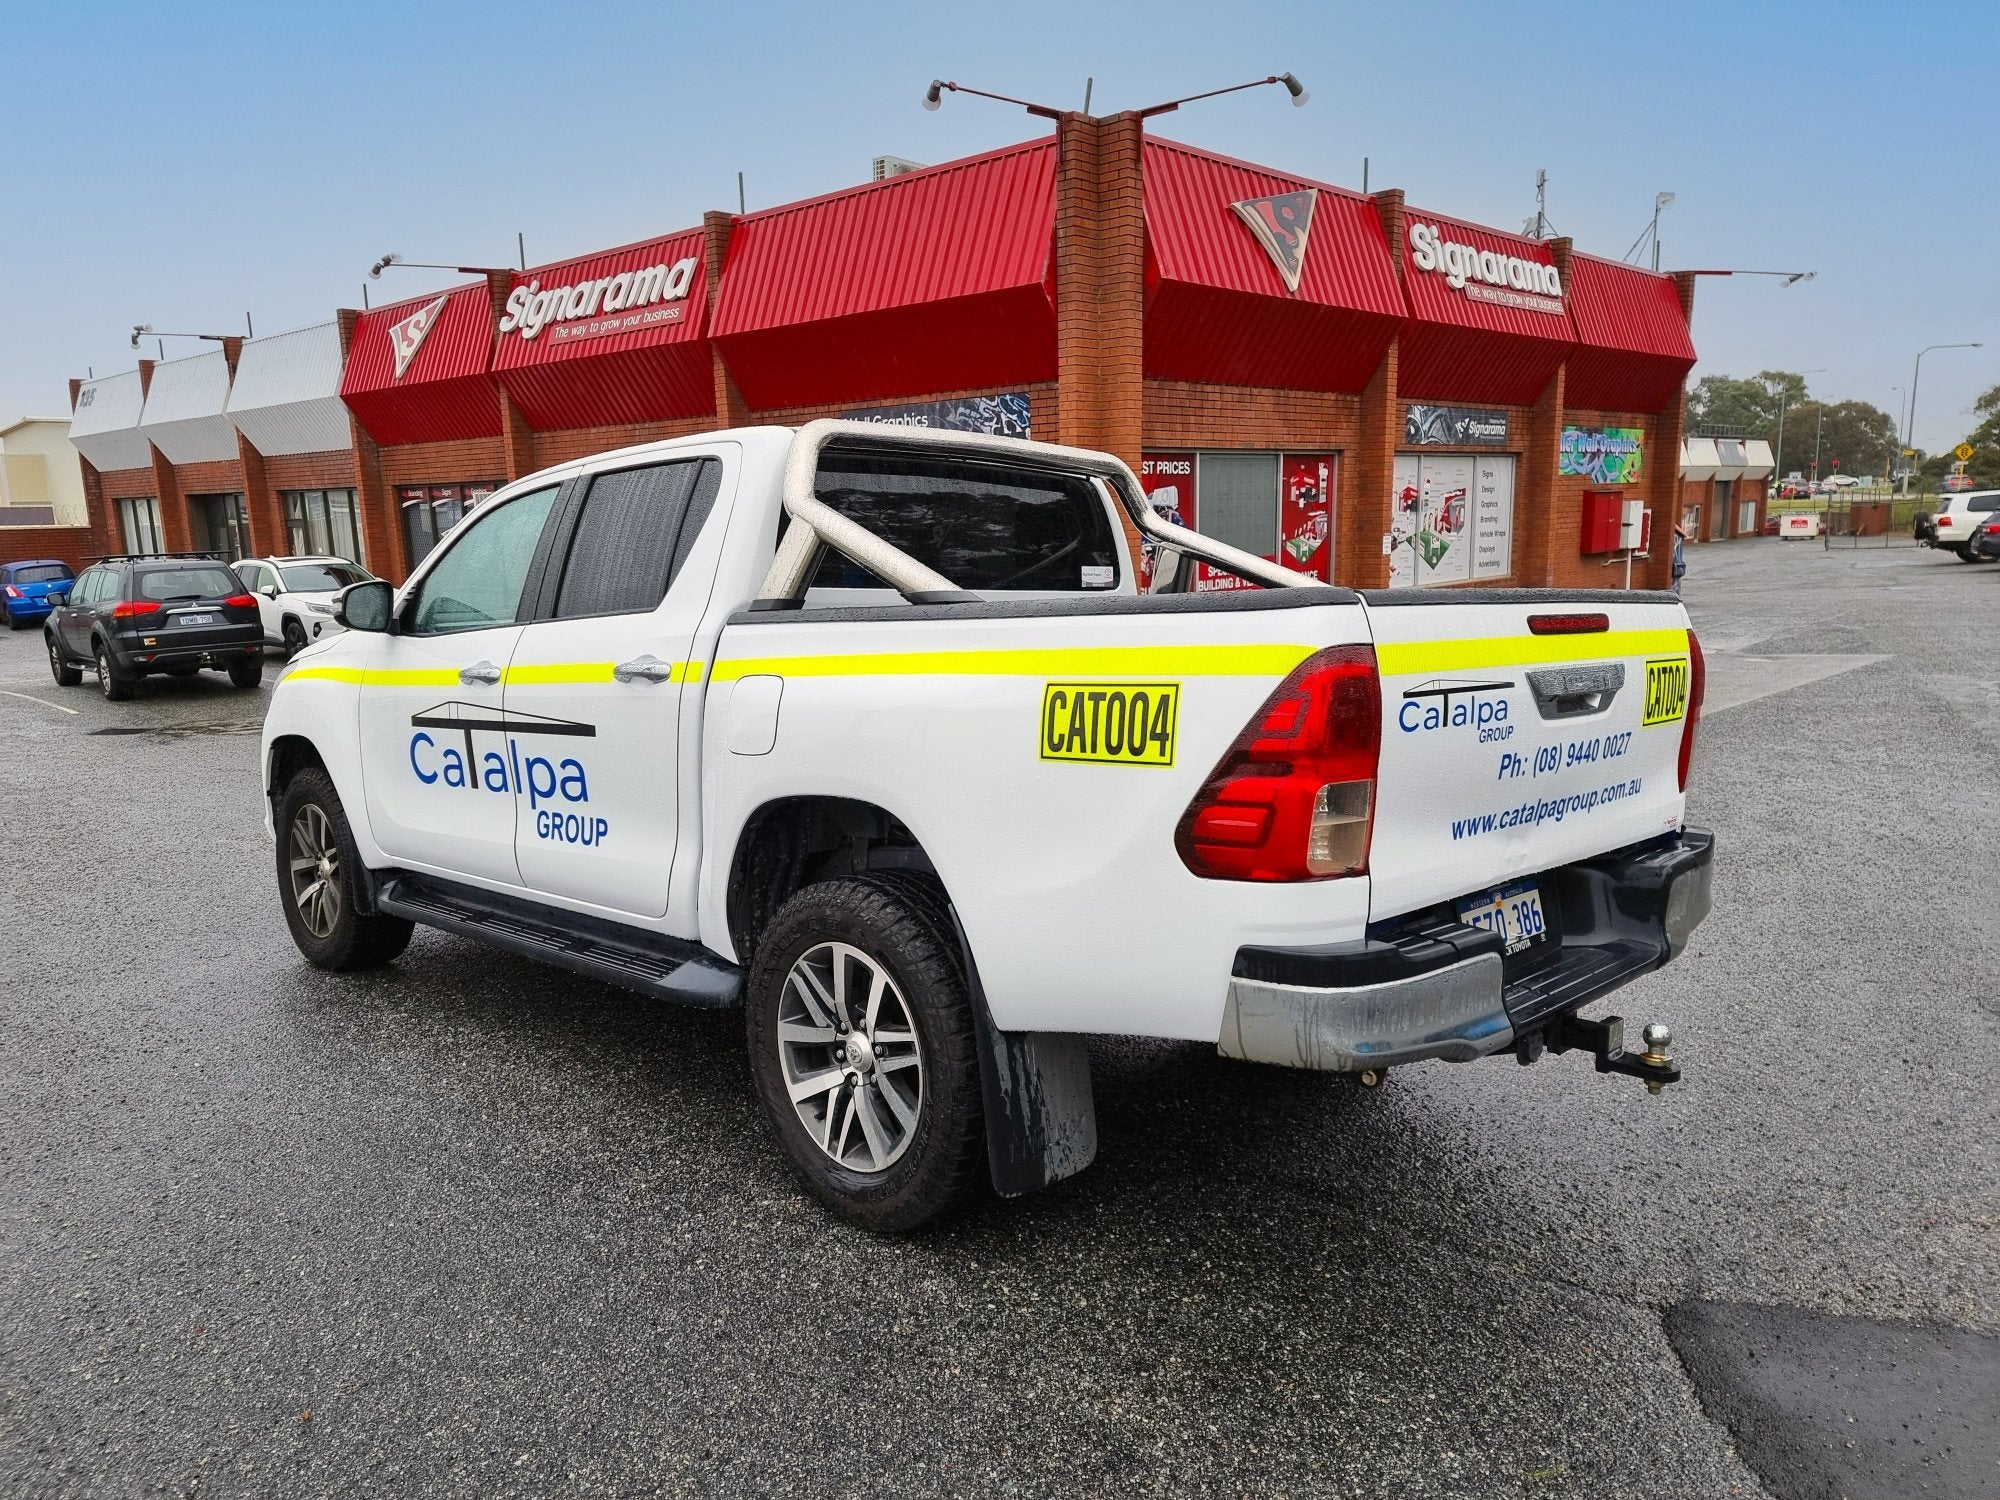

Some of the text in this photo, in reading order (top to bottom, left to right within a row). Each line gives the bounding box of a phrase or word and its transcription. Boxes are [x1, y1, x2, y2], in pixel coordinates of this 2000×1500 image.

[1409, 223, 1563, 297] Signarama
[499, 256, 698, 340] Signarama
[1466, 284, 1564, 312] The way to grow your business
[554, 306, 681, 338] The way to grow your business
[1469, 420, 1506, 437] Signarama
[1156, 461, 1190, 474] PRICES
[1482, 470, 1493, 479] Signs
[1481, 485, 1495, 494] Design
[1481, 500, 1498, 510] Graphics
[1480, 516, 1498, 524] Branding
[1494, 530, 1506, 538] Wraps
[1479, 546, 1495, 554] Displays
[1479, 560, 1500, 568] Advertising
[1199, 578, 1233, 591] BUILDING
[1235, 577, 1241, 588] &
[1646, 665, 1687, 720] CAT004
[1047, 690, 1171, 758] CAT004
[1479, 725, 1514, 743] GROUP
[1498, 731, 1632, 780] Ph: (08) 9440 0027
[1452, 776, 1642, 841] www.catalpagroup.com.au
[537, 810, 608, 847] GROUP
[1512, 898, 1542, 936] 386
[1512, 938, 1531, 954] TOYOTA
